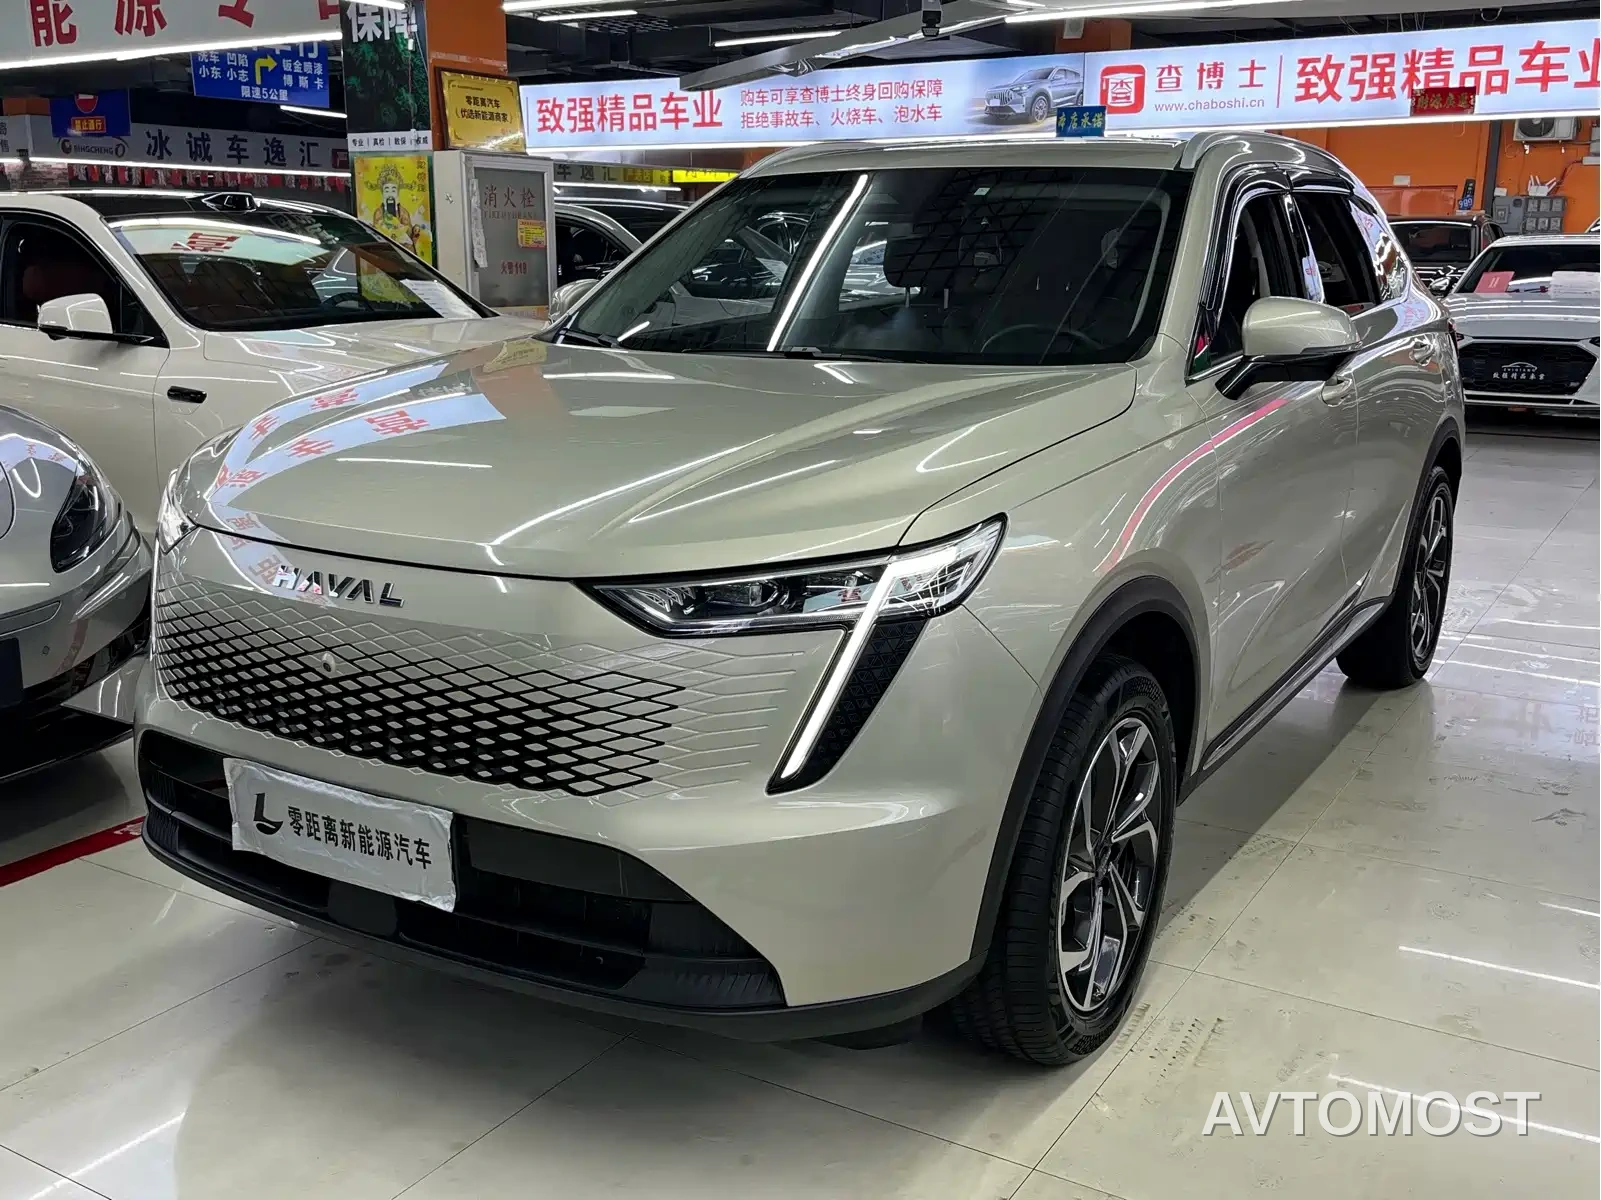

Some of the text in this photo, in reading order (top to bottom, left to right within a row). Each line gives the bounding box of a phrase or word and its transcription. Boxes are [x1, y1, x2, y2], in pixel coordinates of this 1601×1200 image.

[347, 2, 417, 42] 保障
[199, 65, 249, 82] 小东 小志
[1155, 59, 1267, 93] 查博士
[241, 85, 289, 101] 限速5公里
[465, 95, 501, 109] 零距离汽车
[740, 79, 943, 107] 购车可享查博士终身回购保障
[1154, 97, 1265, 112] www.chaboshi.cn
[536, 91, 723, 134] 致强精品车业
[740, 103, 943, 129] 拒绝事故车、火烧车、泡水车
[146, 129, 321, 168] 冰诚车逸汇
[484, 184, 536, 209] 消火栓
[271, 564, 406, 608] HAVAL
[288, 806, 432, 870] 零距离新能源汽车
